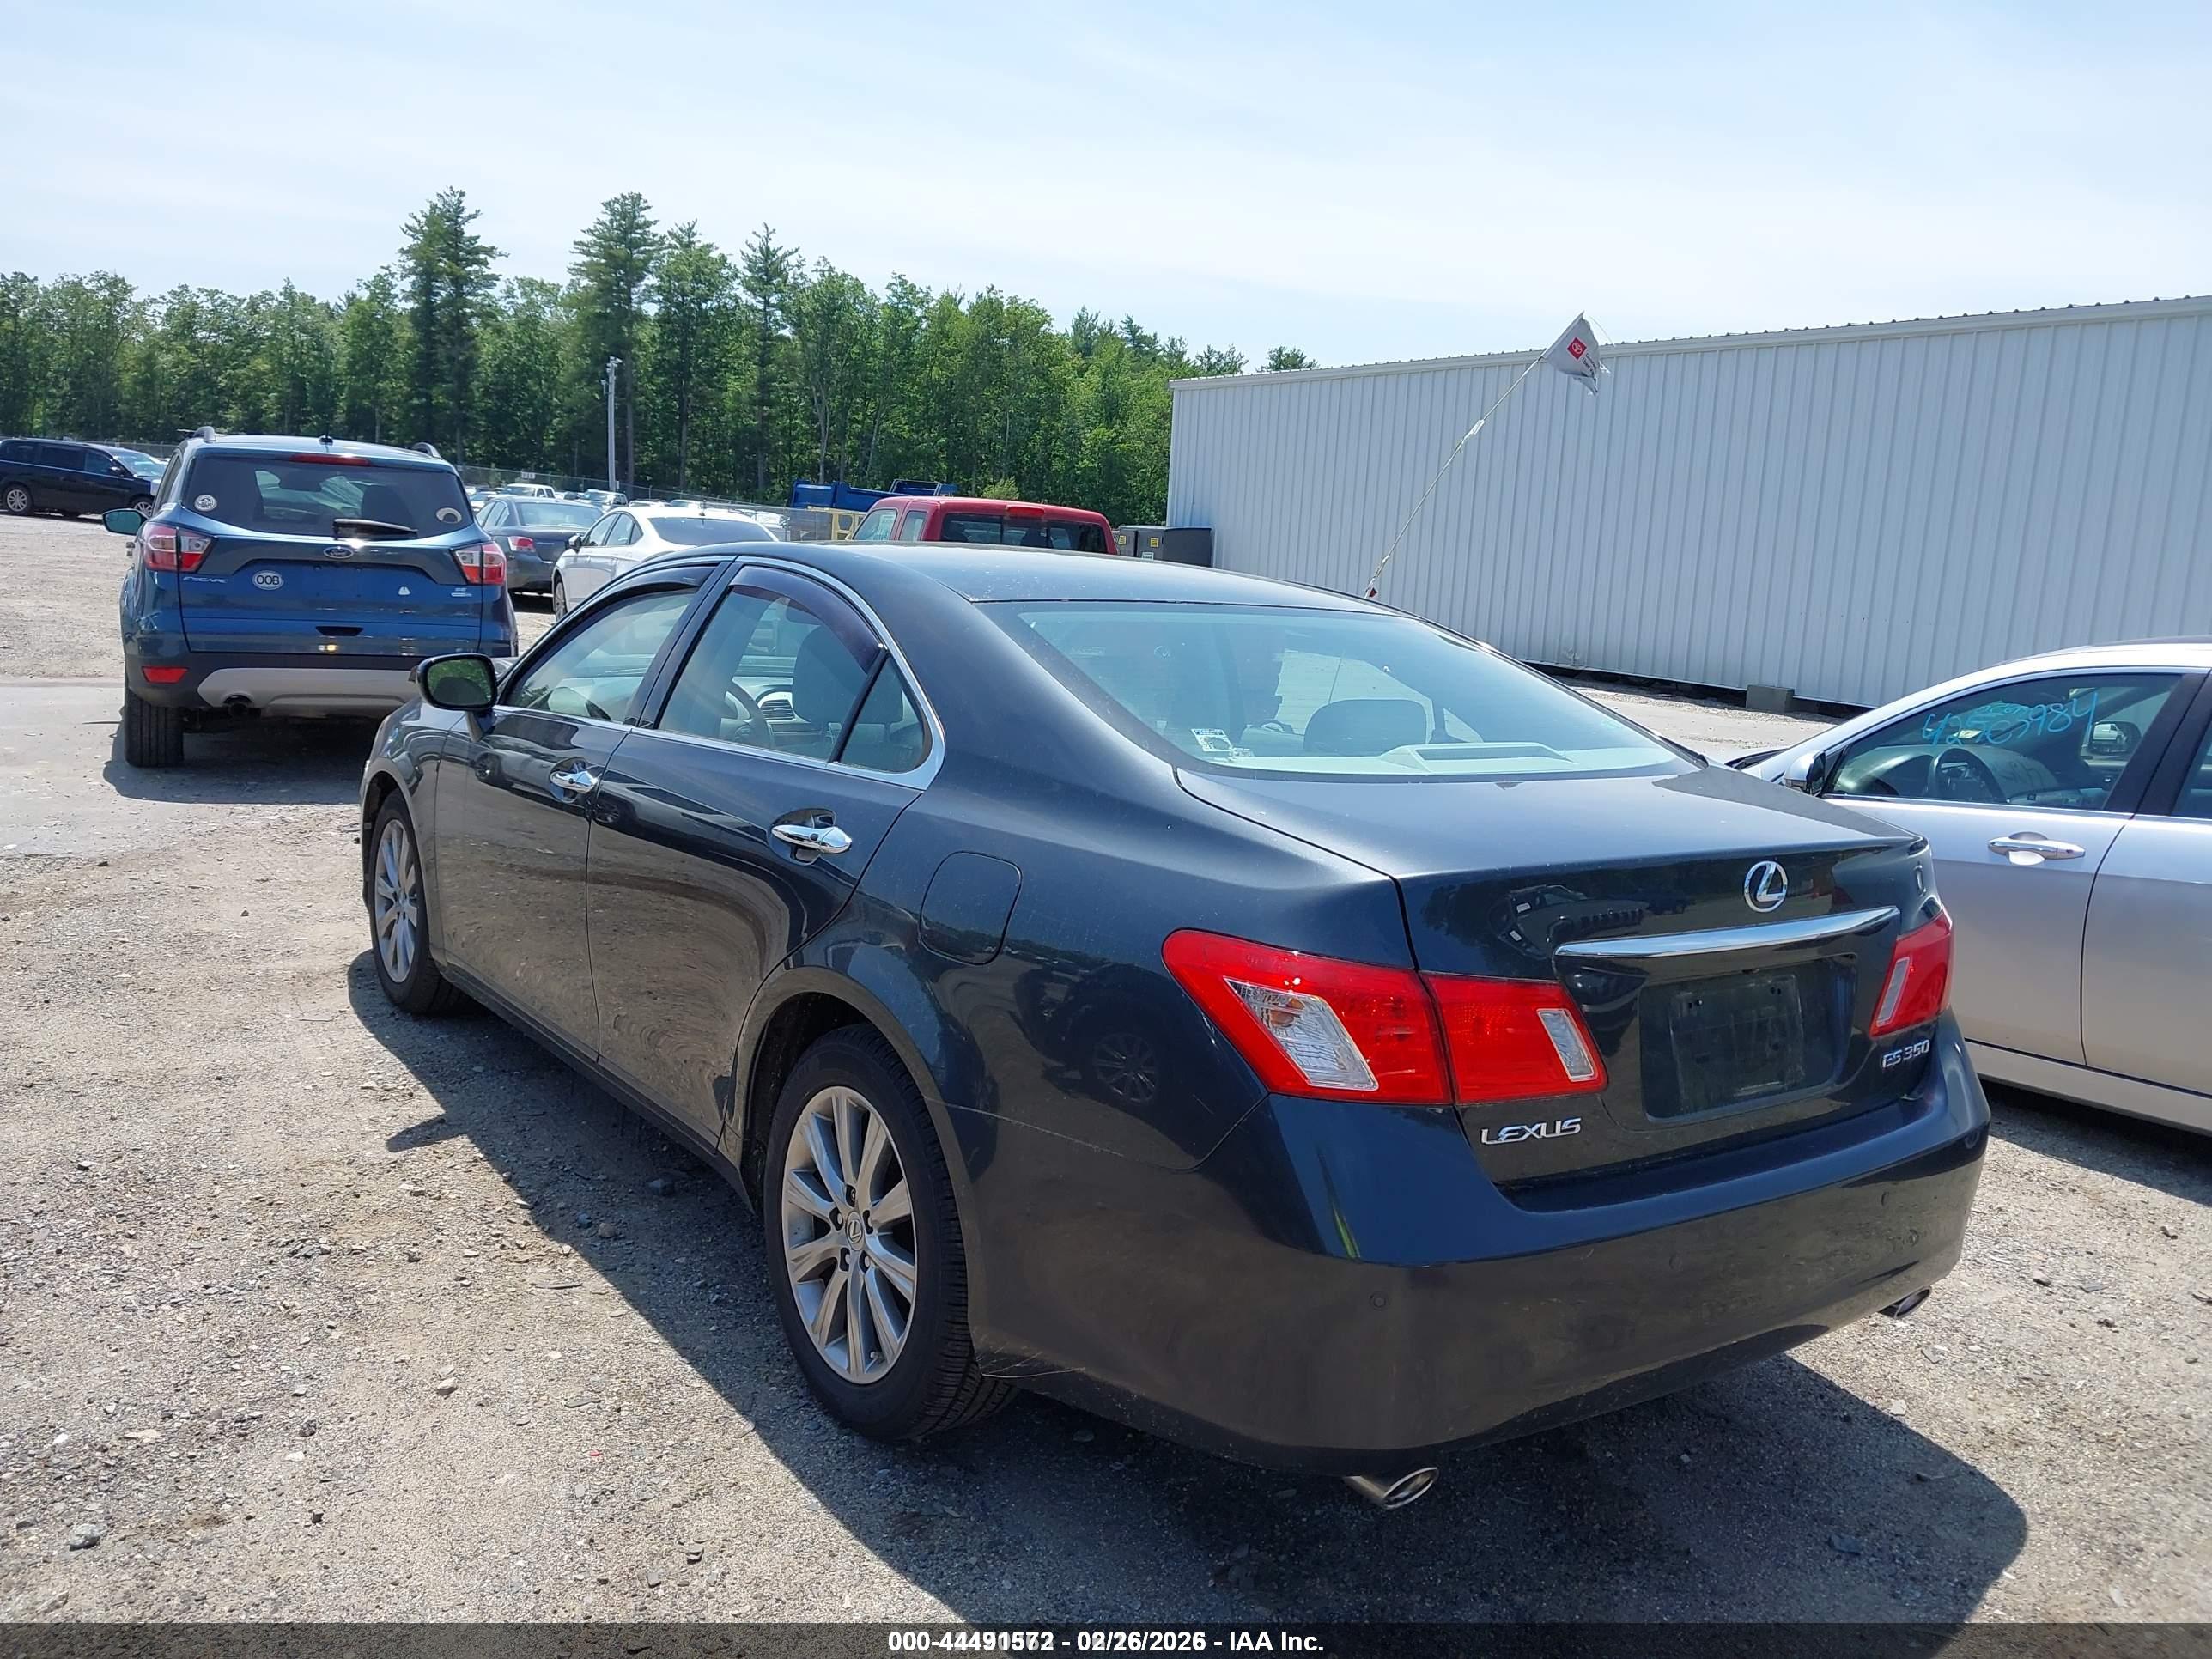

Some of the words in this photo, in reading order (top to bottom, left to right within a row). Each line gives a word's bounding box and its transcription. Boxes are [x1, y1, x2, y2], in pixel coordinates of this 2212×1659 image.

[1882, 1049, 1903, 1068] ES
[1903, 1039, 1930, 1061] 350
[1481, 1117, 1582, 1145] LEXUS
